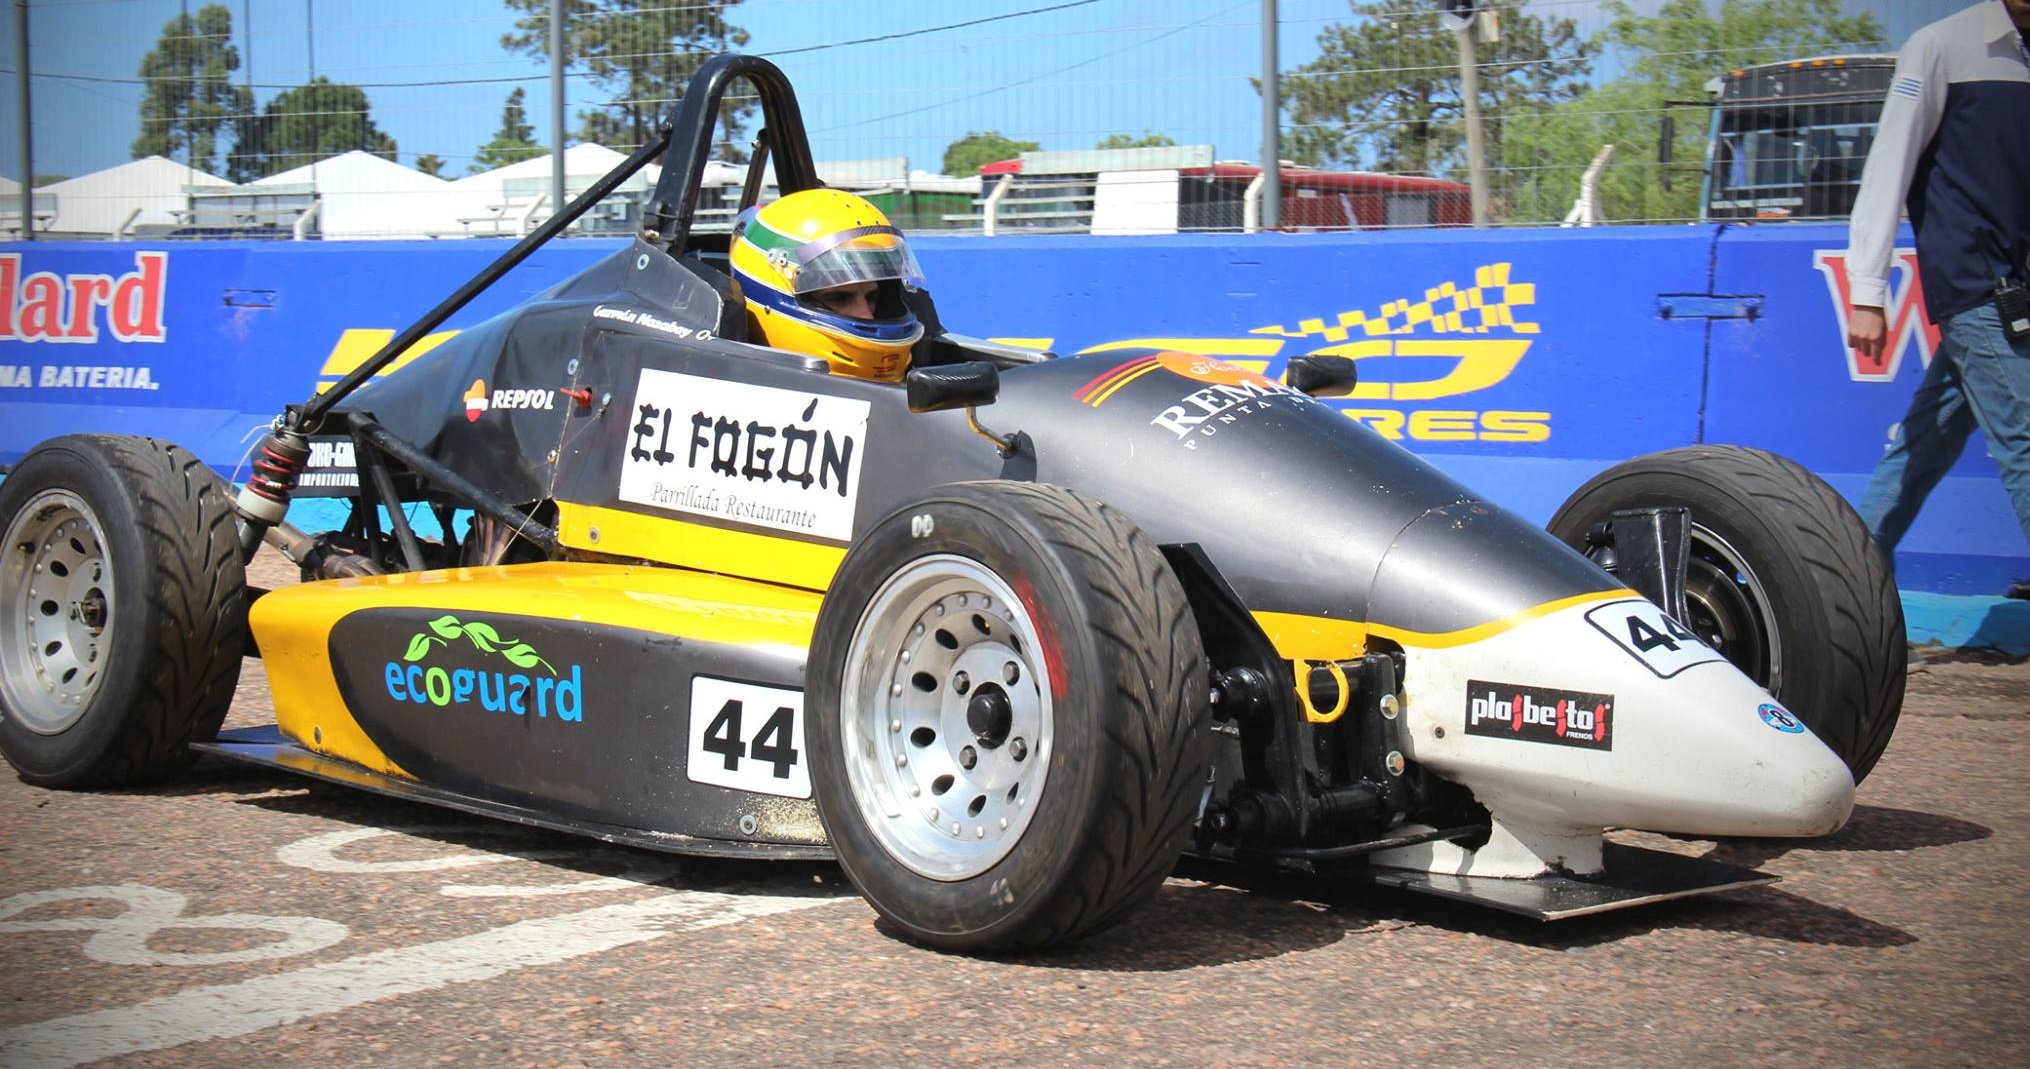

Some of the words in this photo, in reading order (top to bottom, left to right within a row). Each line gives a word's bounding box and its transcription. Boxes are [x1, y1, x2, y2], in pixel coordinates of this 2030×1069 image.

[0, 251, 168, 343] lard
[39, 366, 160, 390] BATERIA.
[491, 389, 555, 410] REPSOL
[688, 398, 854, 498] FOGÓN
[1184, 400, 1271, 450] PUNTA
[651, 482, 720, 513] Parrillada
[725, 494, 817, 529] Restaurante
[385, 661, 583, 722] ecoguard
[703, 699, 798, 780] 44
[1566, 731, 1593, 741] FRENOS
